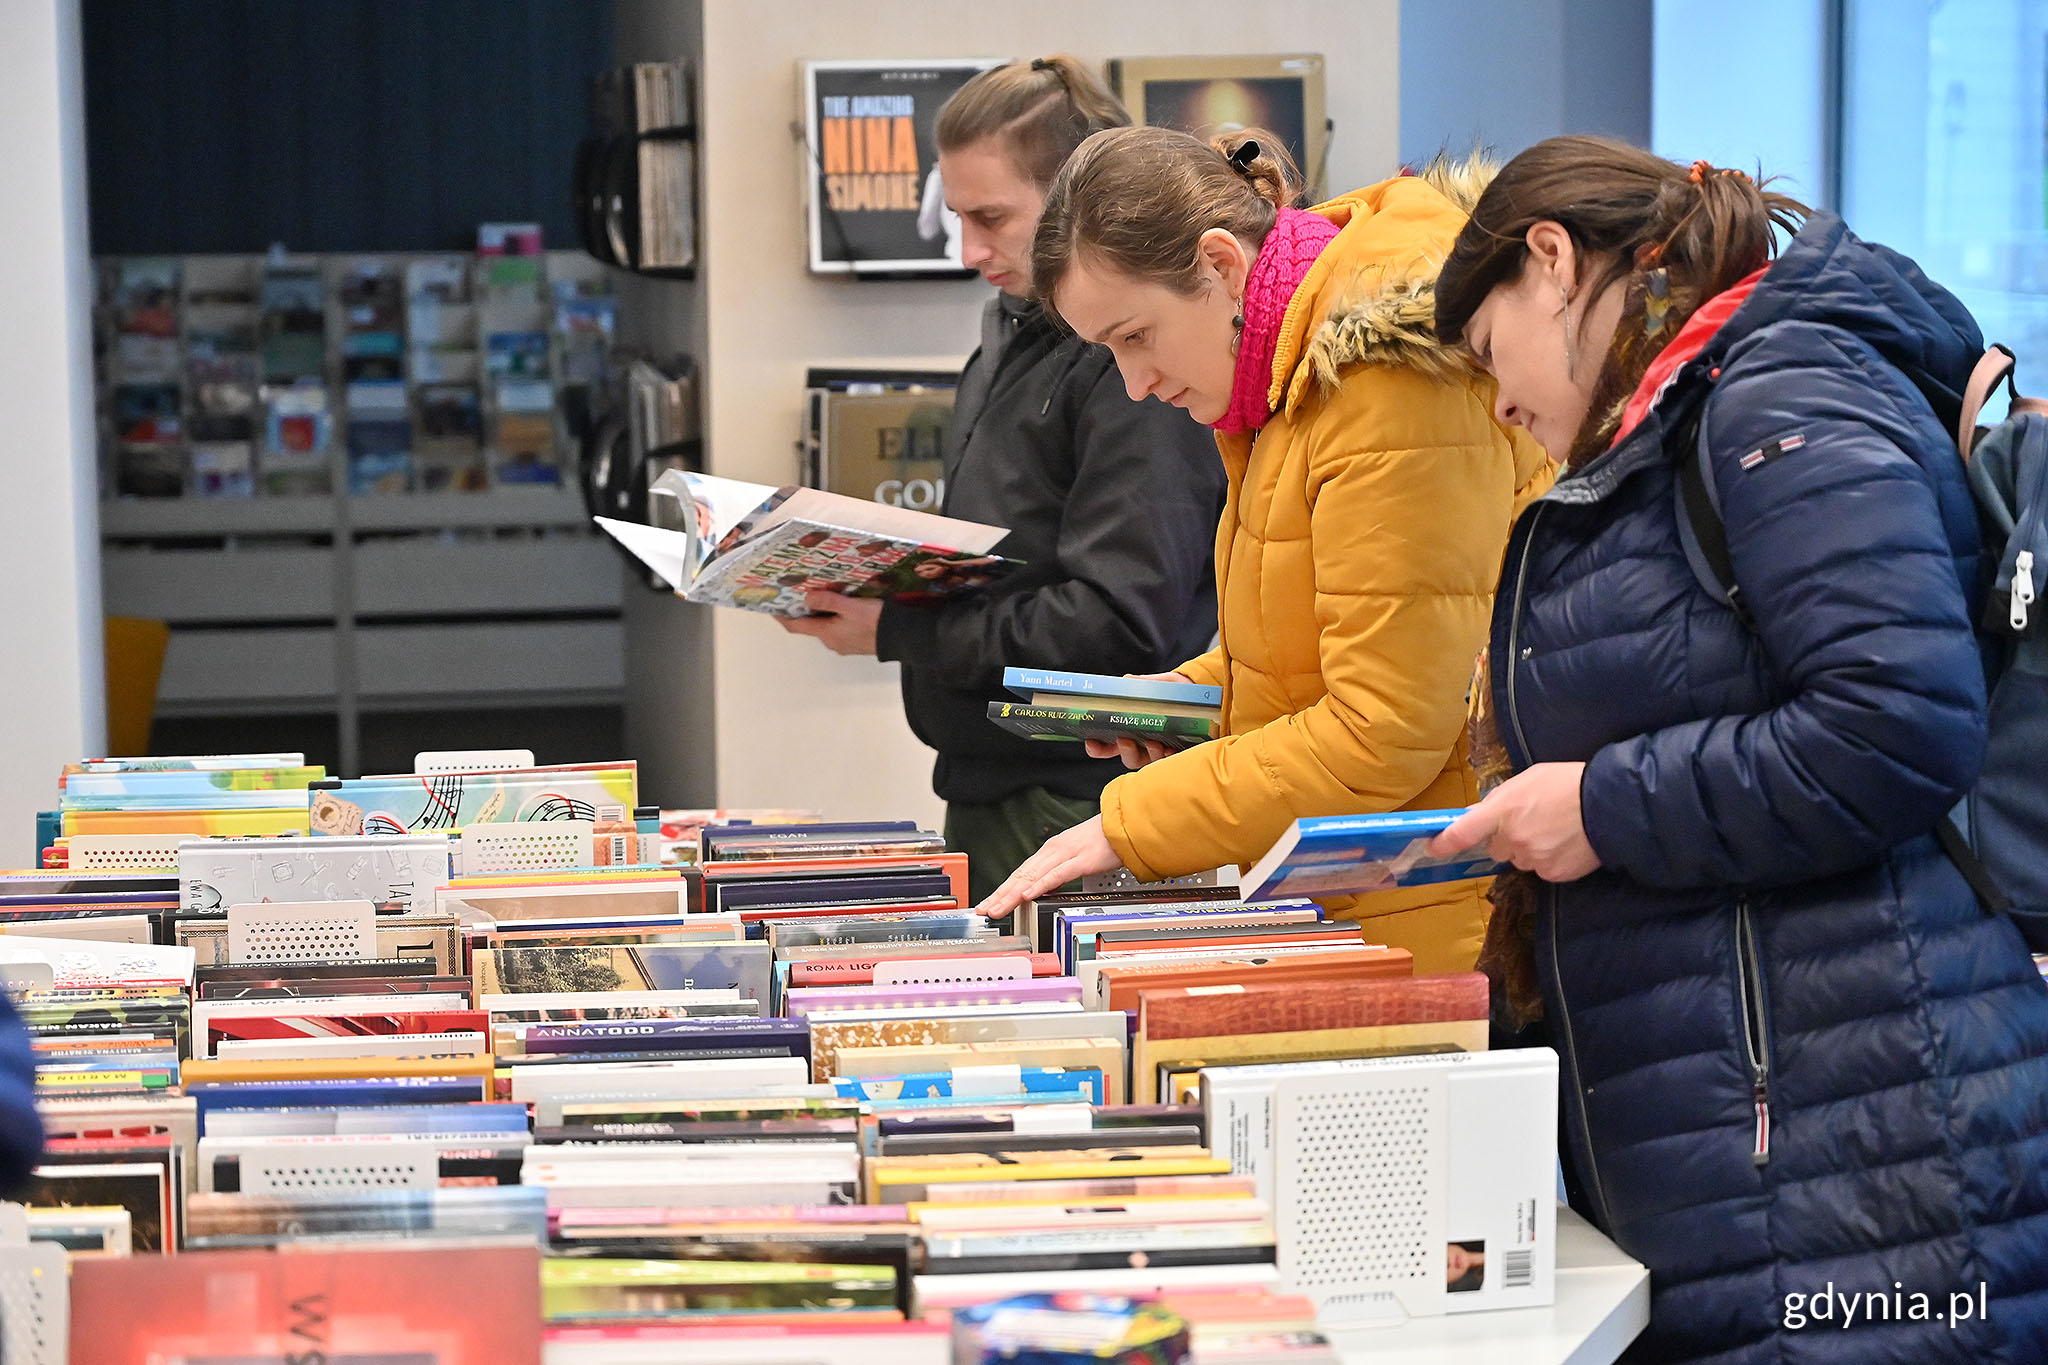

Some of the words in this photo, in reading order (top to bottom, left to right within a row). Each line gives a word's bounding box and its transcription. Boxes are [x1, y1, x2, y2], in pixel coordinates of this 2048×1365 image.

[823, 117, 919, 174] NINA
[826, 173, 920, 211] SIMONE
[1020, 673, 1042, 685] Yann
[1045, 675, 1073, 687] Martel
[1082, 679, 1094, 690] Ja
[1014, 707, 1047, 718] CARLOS
[1048, 710, 1067, 720] RUIZ
[1067, 710, 1095, 721] ZAFÓN
[1109, 715, 1139, 727] KSIĄŻĘ
[1141, 717, 1165, 727] MGŁY
[1148, 901, 1193, 910] Znaczy
[861, 942, 903, 950] OSOBLIWY
[946, 938, 986, 946] PEREGRINE
[352, 957, 427, 965] ARCHITEKT
[806, 963, 845, 972] ROMA
[57, 1072, 127, 1081] MARCIN
